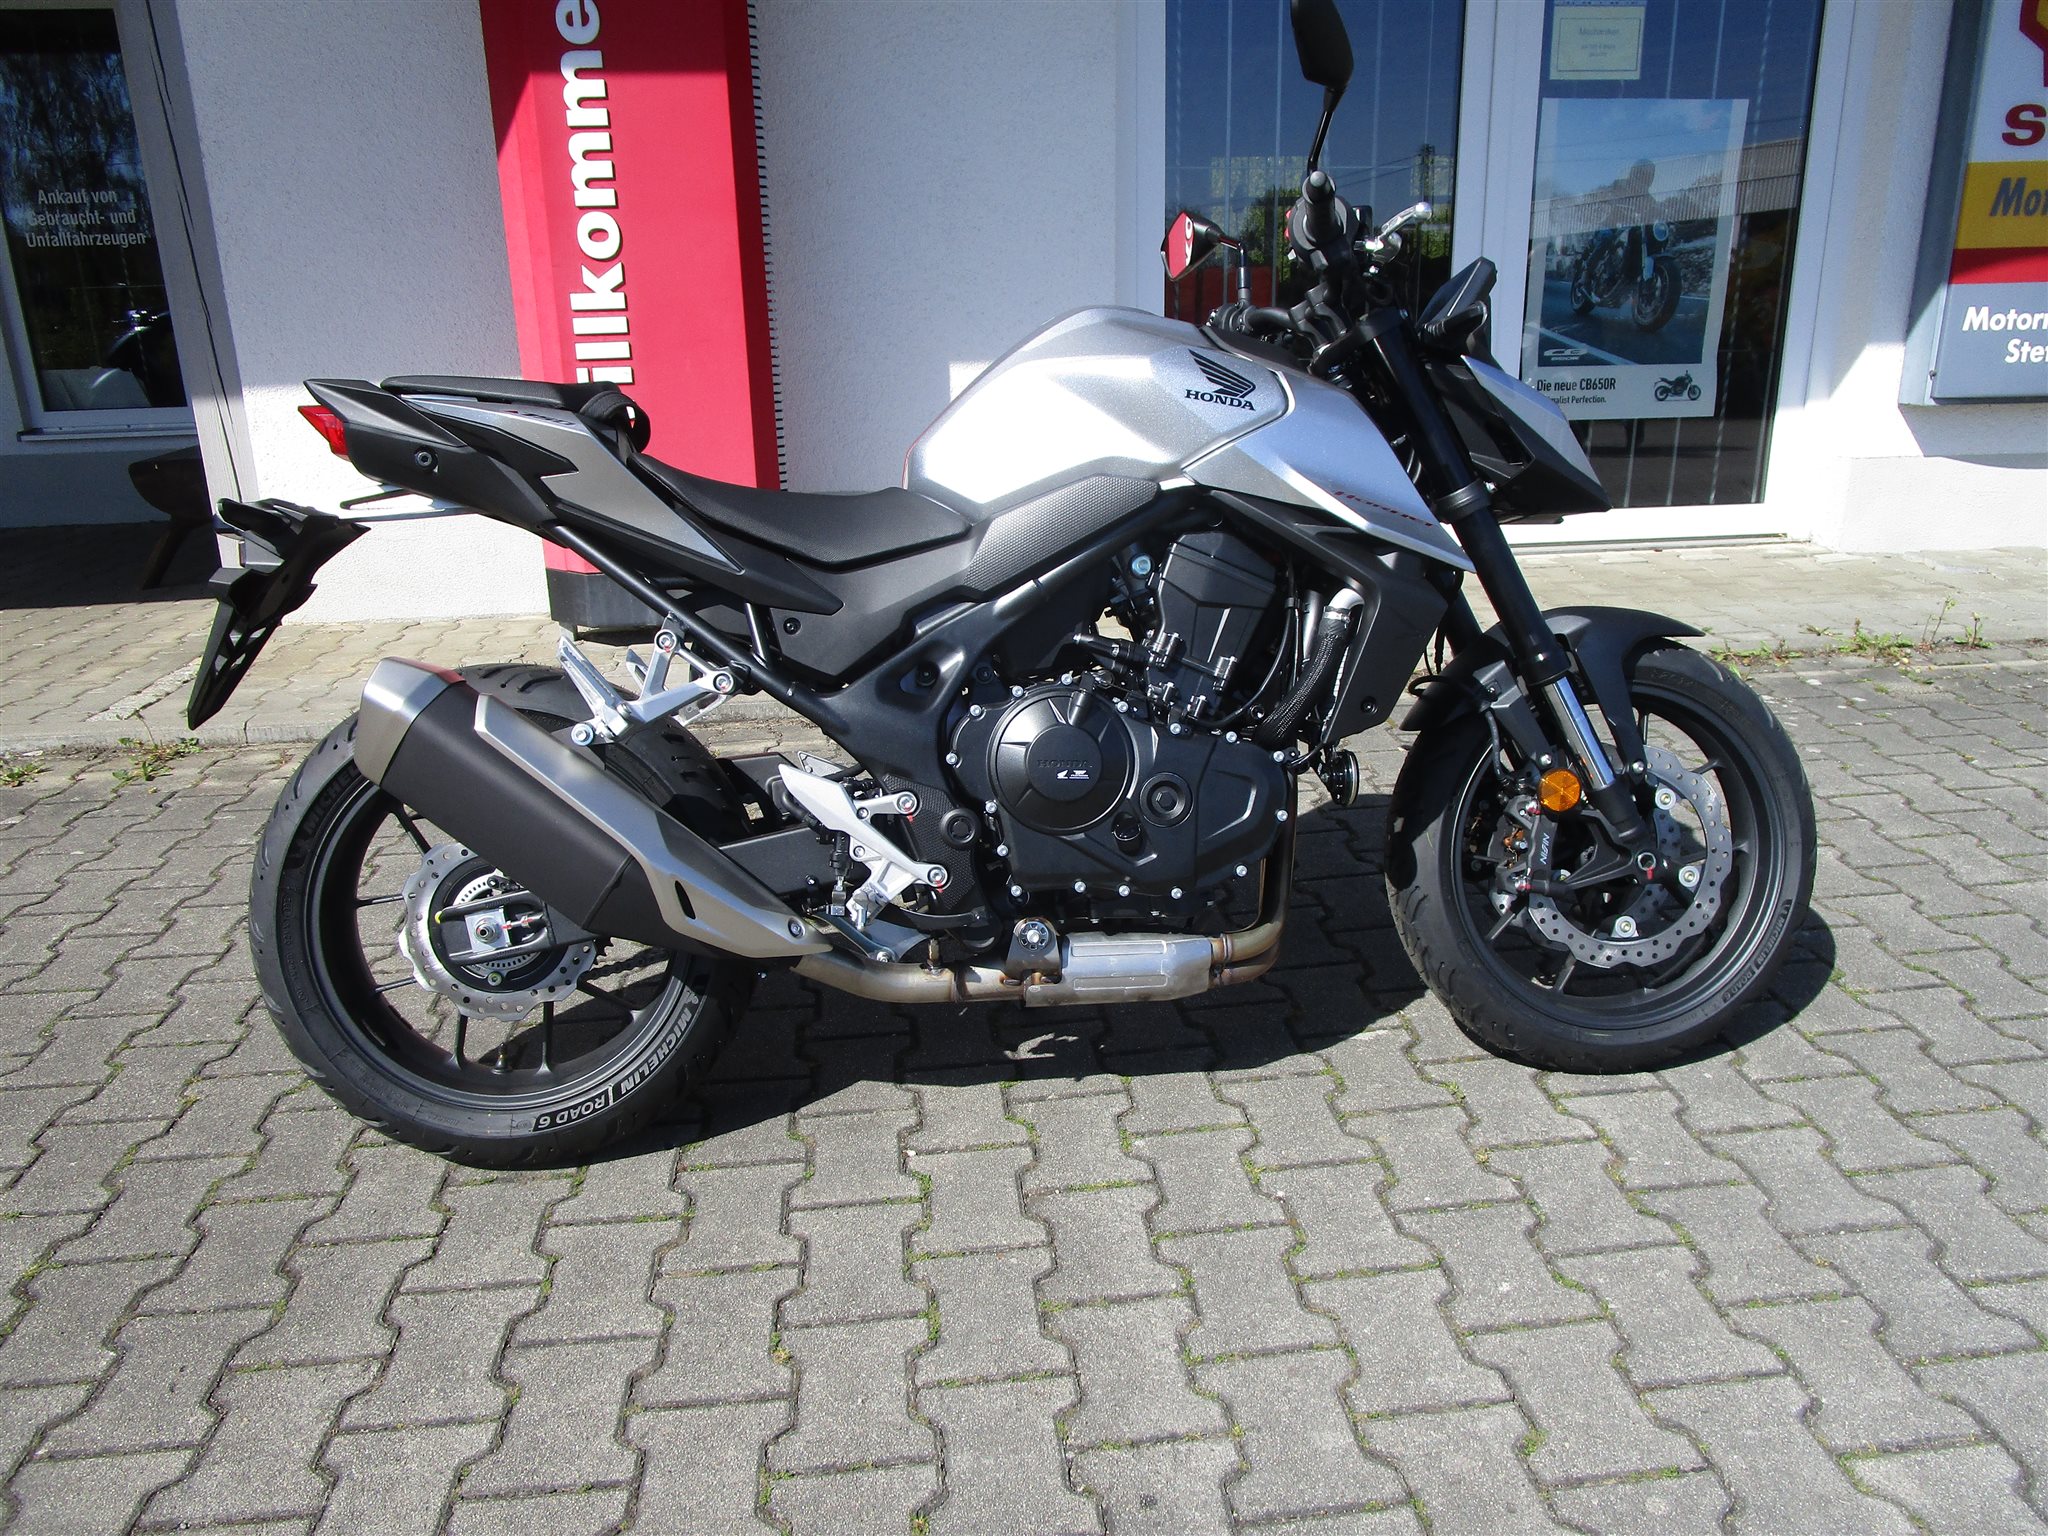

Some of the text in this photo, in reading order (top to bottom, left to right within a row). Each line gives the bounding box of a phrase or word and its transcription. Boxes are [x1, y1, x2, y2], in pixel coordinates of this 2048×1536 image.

[38, 189, 118, 205] Ankauf von
[27, 209, 137, 226] Gebraucht- und
[555, 0, 635, 428] illkomme
[25, 231, 147, 248] Unfallfahrzeugen
[1536, 378, 1616, 391] Die neue CB650R
[1185, 389, 1256, 411] HONDA
[1571, 394, 1606, 404] Perfection.
[1757, 917, 1785, 967] MICHELIN
[1732, 971, 1753, 993] ROAD
[620, 1007, 692, 1095] MICHELIN
[555, 1096, 606, 1125] ROAD
[537, 1115, 551, 1129] 6
